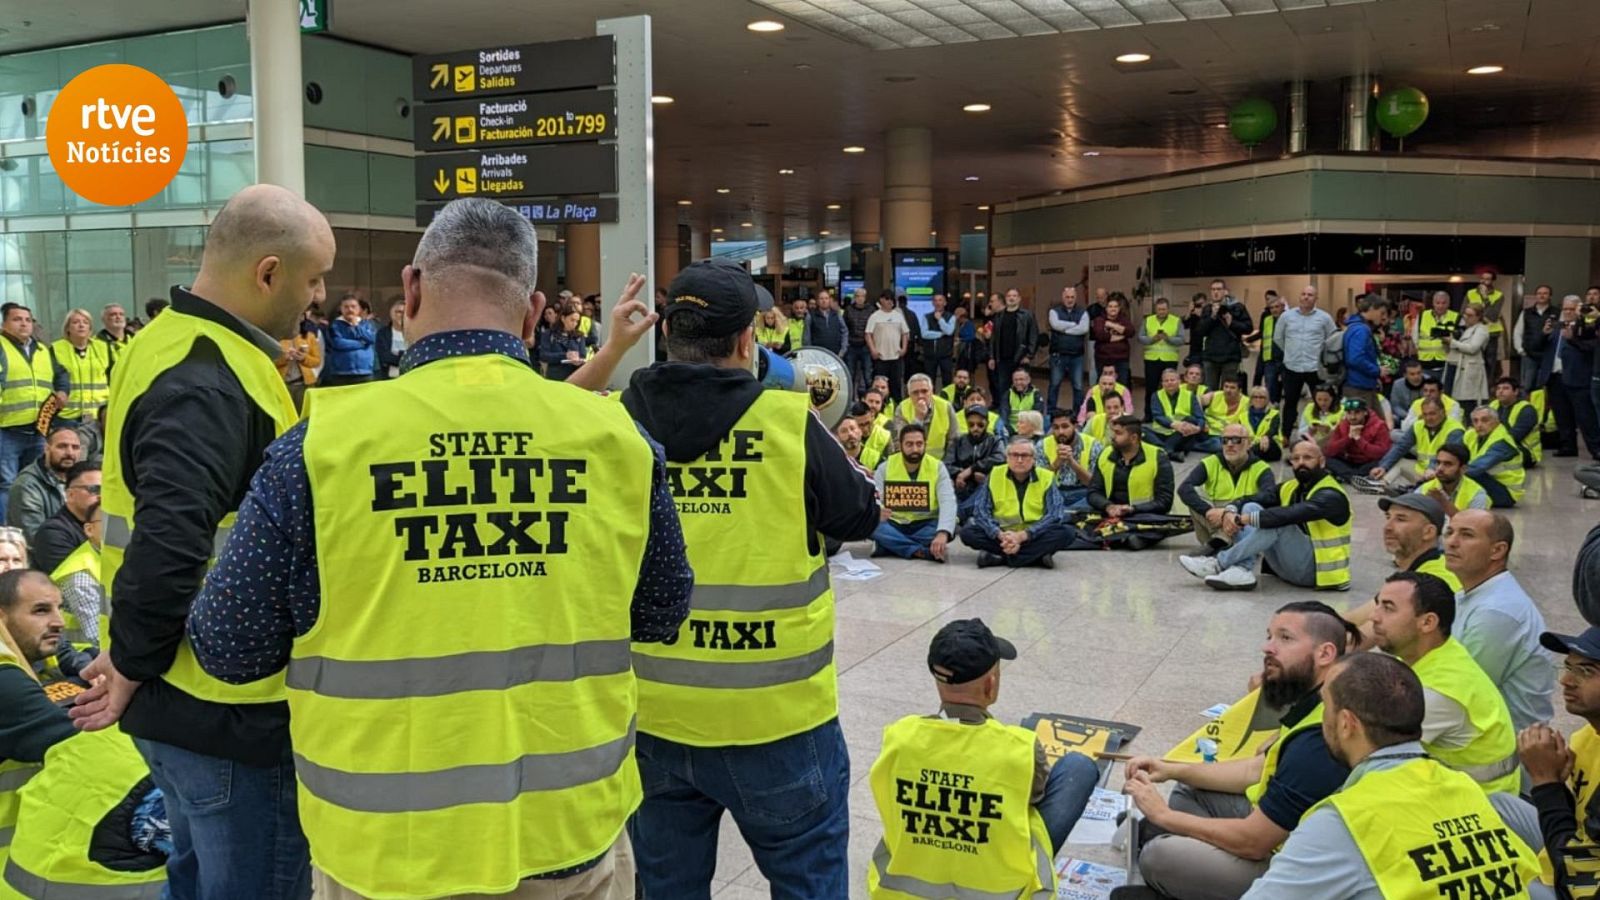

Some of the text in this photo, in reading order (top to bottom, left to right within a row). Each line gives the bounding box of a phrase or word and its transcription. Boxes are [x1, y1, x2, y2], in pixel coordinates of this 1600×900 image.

[480, 50, 520, 63] Sortides
[480, 64, 522, 76] Departures
[480, 77, 516, 89] Salidas
[480, 100, 527, 115] Facturació
[566, 112, 574, 121] to
[480, 116, 514, 128] Check-in
[480, 114, 606, 140] Facturación 201 a 799
[481, 154, 528, 166] Arribades
[481, 168, 513, 179] Arrivals
[481, 180, 524, 192] Llegadas
[546, 204, 597, 222] La Plaça
[1253, 247, 1276, 262] info
[1386, 245, 1414, 261] info
[429, 432, 533, 457] STAFF
[370, 458, 587, 512] ELITE
[665, 467, 747, 498] AXI
[885, 486, 928, 494] HARTOS
[885, 499, 928, 507] HARTOS
[395, 511, 569, 561] TAXI
[418, 561, 547, 583] BARCELONA
[690, 620, 776, 650] TAXI
[920, 768, 974, 790] STAFF
[896, 777, 1003, 821] ELITE
[901, 809, 990, 844] TAXI
[1433, 814, 1483, 839] STAFF
[912, 836, 979, 855] BARCELONA
[1407, 828, 1519, 882] ELITE
